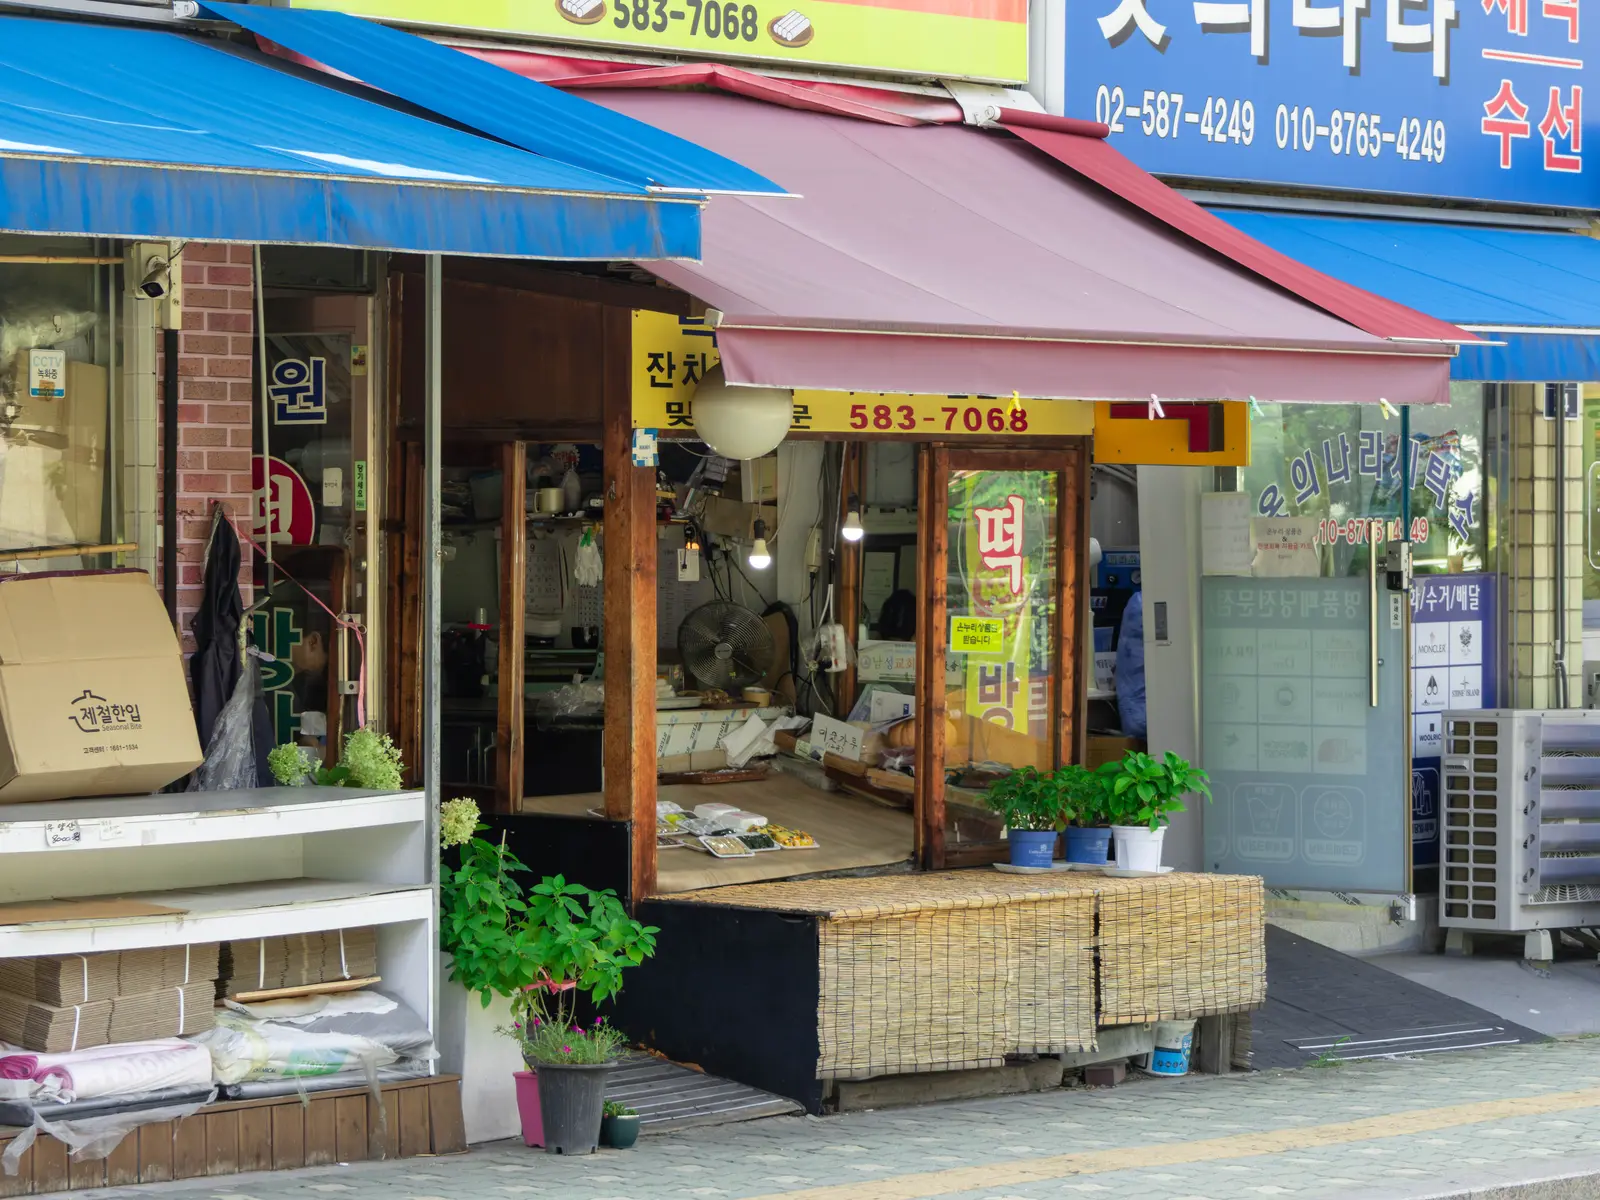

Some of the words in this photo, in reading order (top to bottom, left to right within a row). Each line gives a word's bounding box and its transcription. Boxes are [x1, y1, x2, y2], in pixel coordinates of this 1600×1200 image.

[613, 0, 758, 42] 583-7068
[1095, 84, 1255, 146] 02-587-4249
[1275, 103, 1446, 163] 010-8765-4249
[1481, 79, 1582, 173] 수선
[33, 356, 62, 367] CCTV
[850, 404, 1028, 432] 583-7068
[974, 495, 1025, 594] 떡
[1418, 644, 1446, 653] MONCLER
[80, 704, 141, 725] 제철한입
[102, 724, 129, 732] Seasonal
[1419, 733, 1442, 742] WOOLRIC
